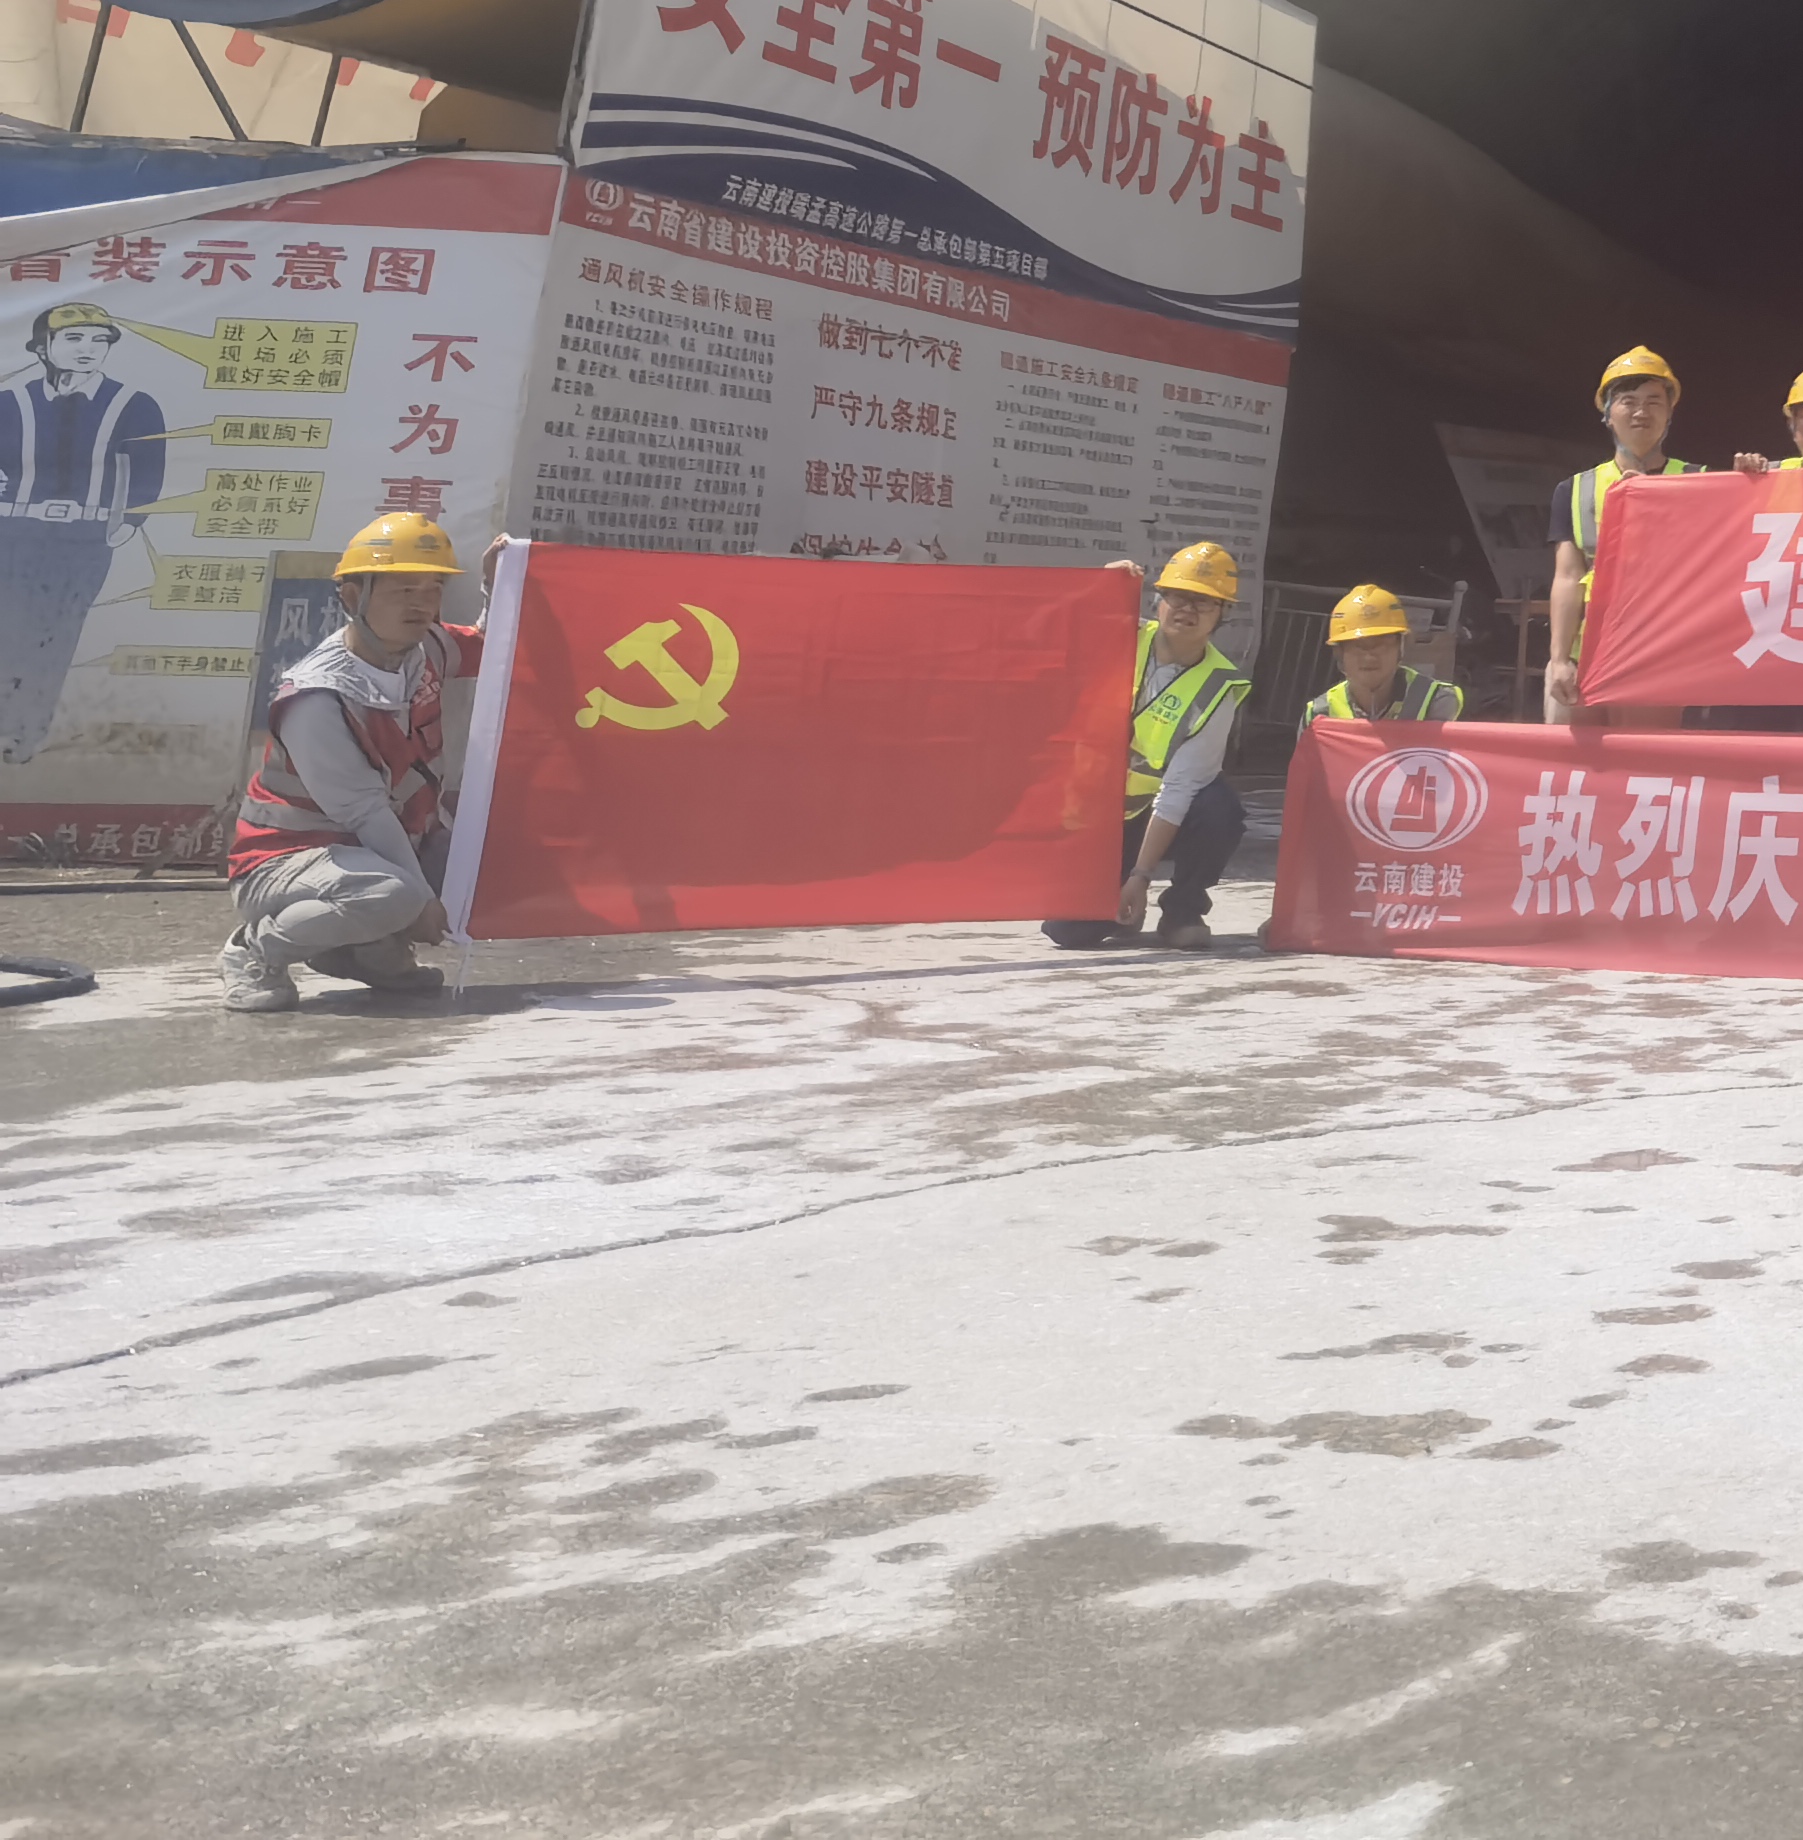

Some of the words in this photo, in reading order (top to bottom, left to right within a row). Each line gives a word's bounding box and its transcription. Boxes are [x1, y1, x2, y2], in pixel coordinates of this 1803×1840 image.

[1033, 33, 1287, 233] 预防为主
[627, 192, 1011, 323] 云南省建设投资控股集团有限公司
[222, 323, 350, 346] 进入施工
[214, 366, 342, 389] 戴好安全帽
[216, 472, 313, 494] 高处作业
[206, 517, 280, 536] 安全带
[1353, 862, 1464, 899] 云南建投
[1371, 902, 1438, 931] YCIH
